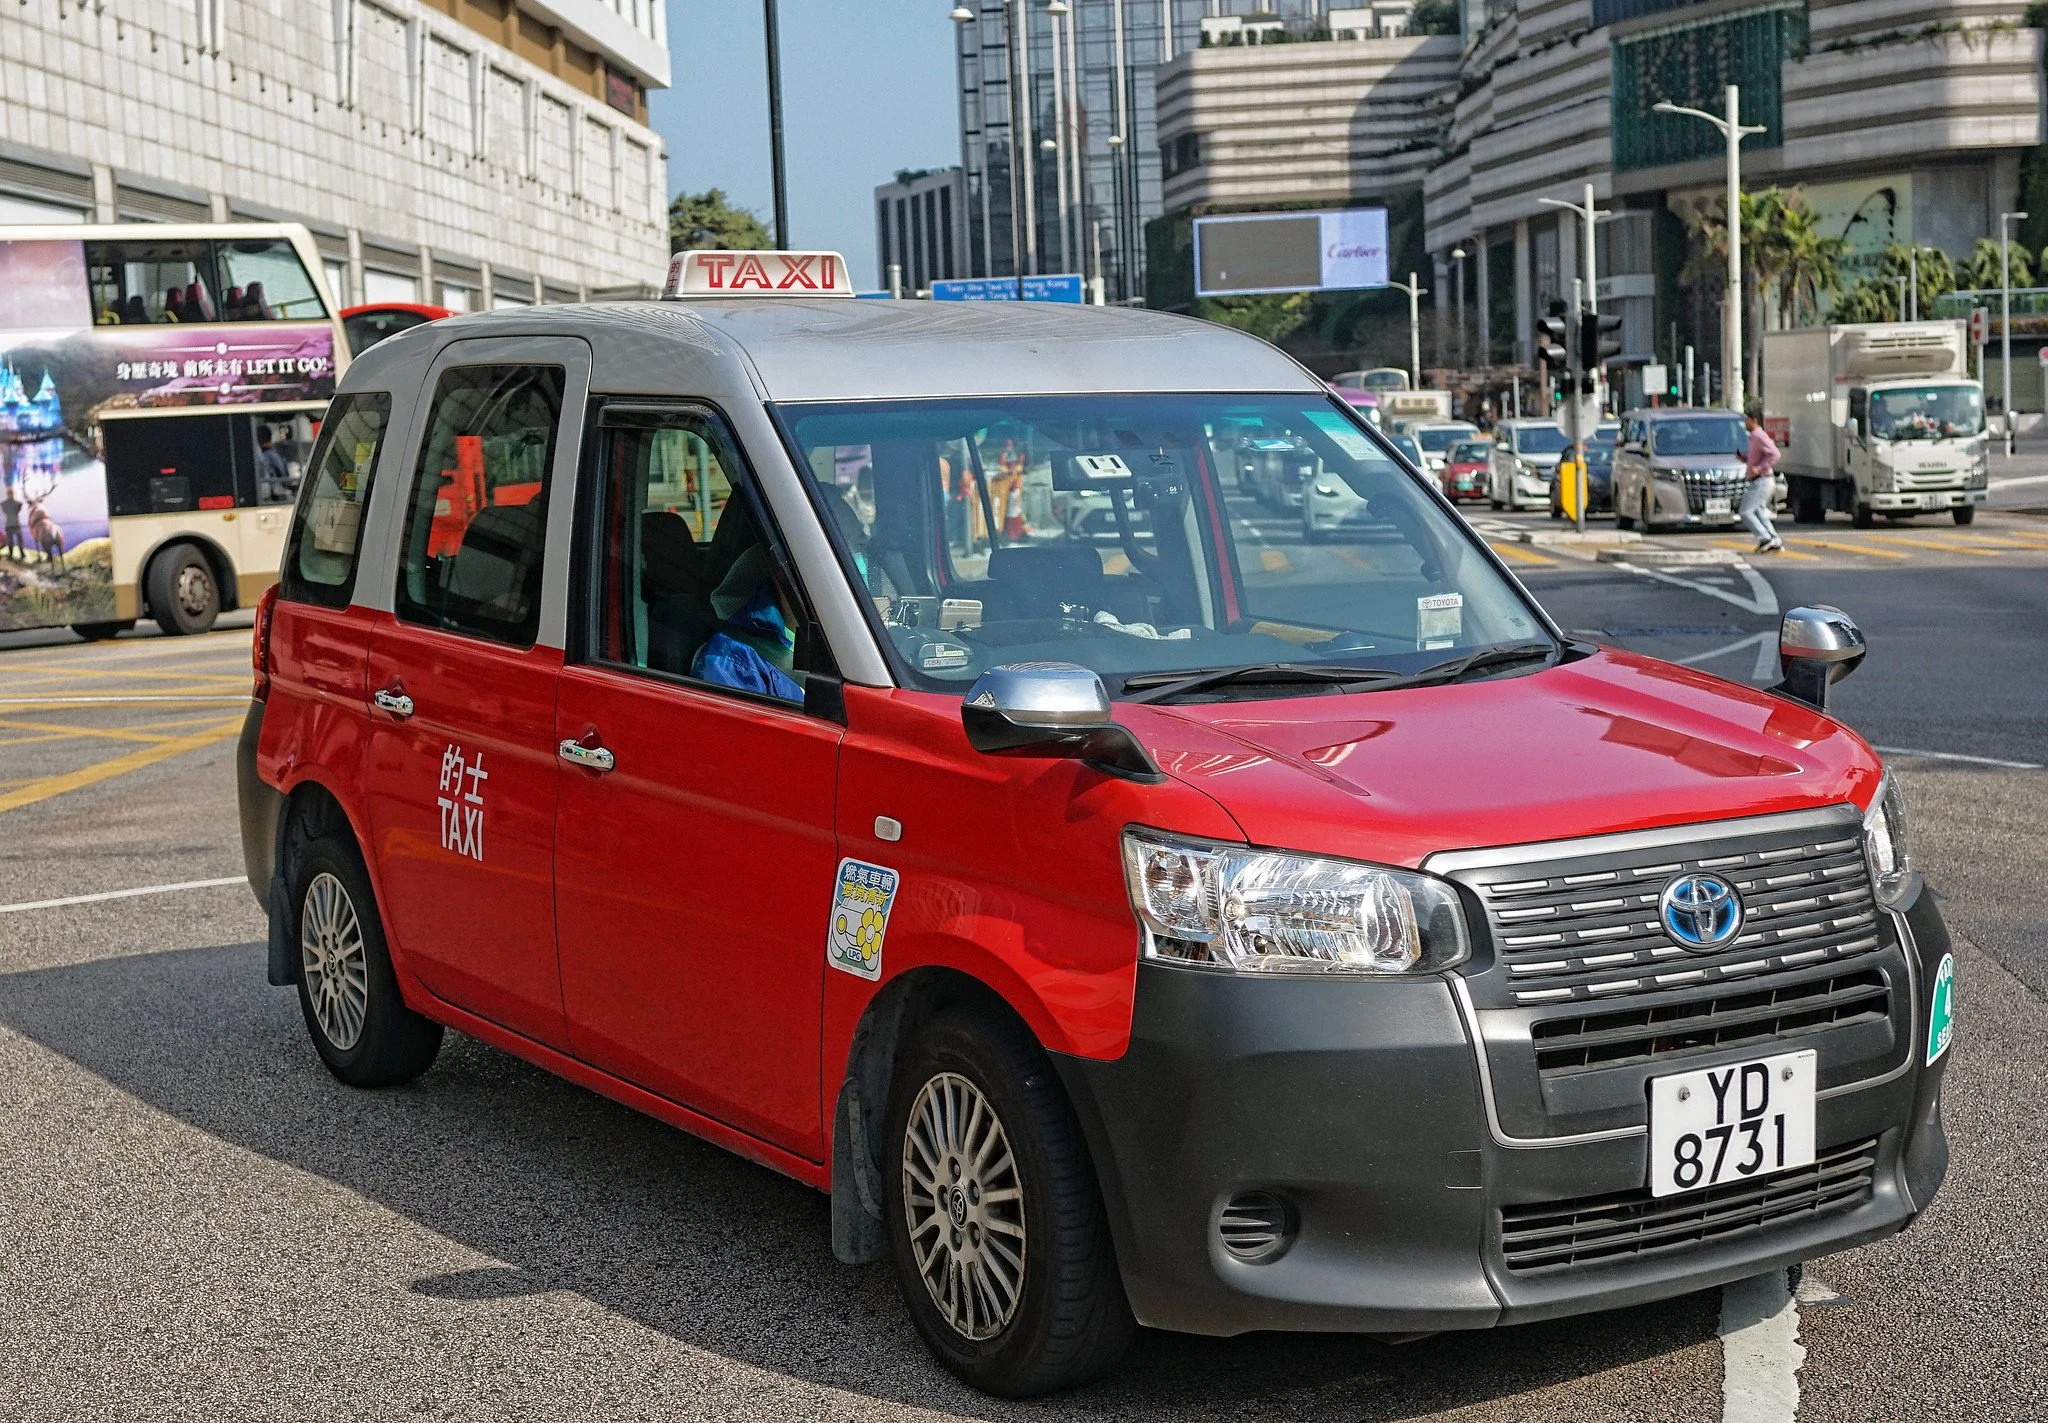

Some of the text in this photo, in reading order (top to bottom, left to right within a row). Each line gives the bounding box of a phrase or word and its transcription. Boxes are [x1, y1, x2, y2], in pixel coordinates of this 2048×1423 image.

[697, 254, 835, 289] TAXI
[183, 359, 242, 377] 前所未有
[246, 356, 328, 374] LET IT GO!
[1432, 598, 1459, 607] TOYOTA
[439, 743, 488, 805] 的士
[437, 796, 484, 861] TAXI
[848, 950, 861, 960] LPG
[1707, 1062, 1769, 1125] YD
[1673, 1113, 1785, 1189] 8731
